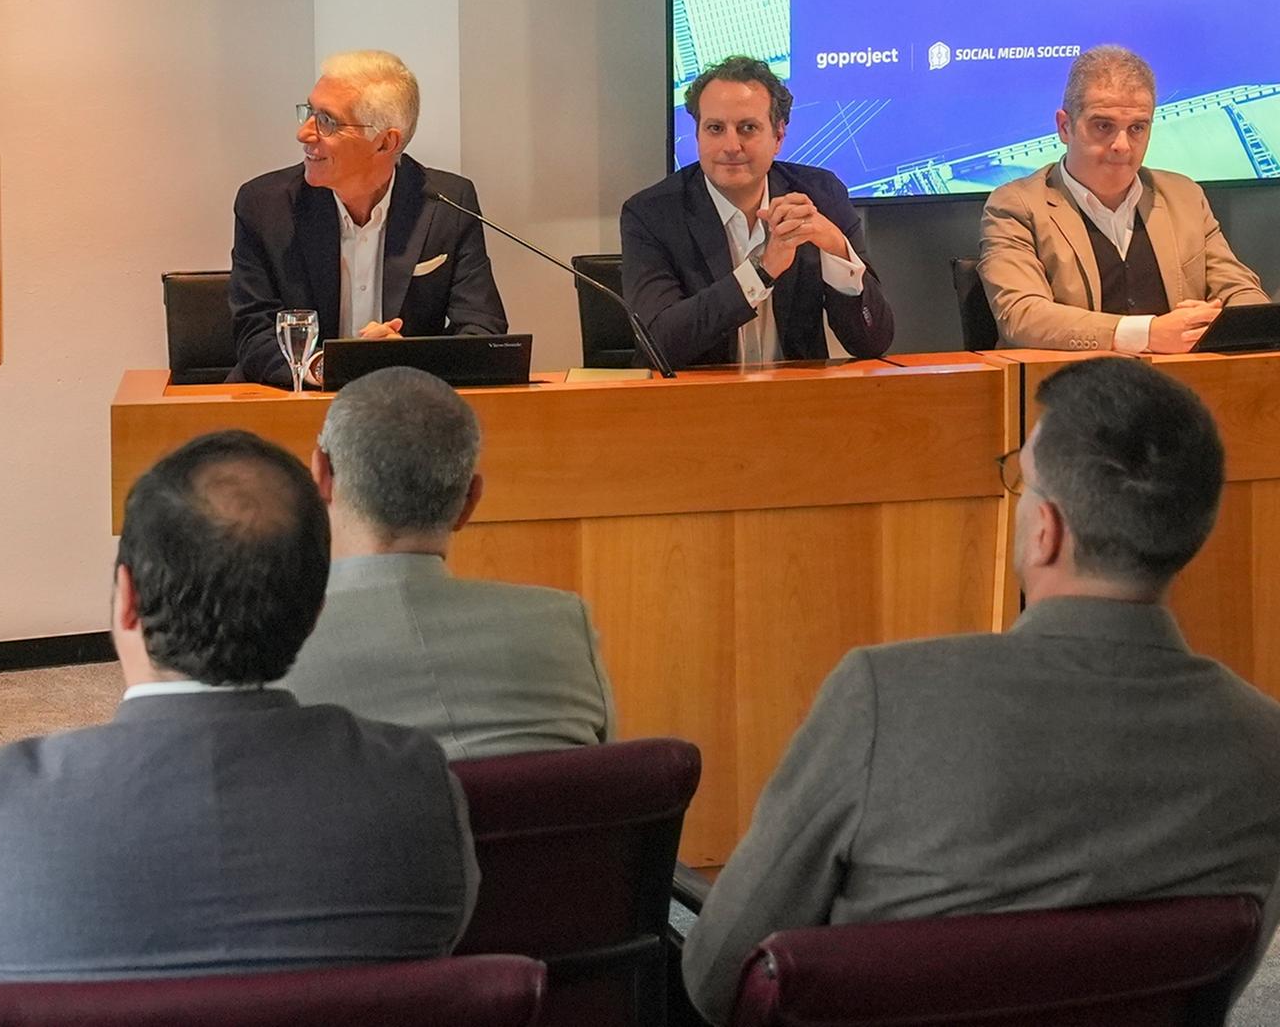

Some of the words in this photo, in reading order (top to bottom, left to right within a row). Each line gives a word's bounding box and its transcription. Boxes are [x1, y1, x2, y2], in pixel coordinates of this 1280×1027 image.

[817, 47, 898, 68] goproject
[956, 48, 995, 61] SOCIAL
[998, 47, 1035, 59] MEDIA
[1037, 45, 1080, 57] SOCCER
